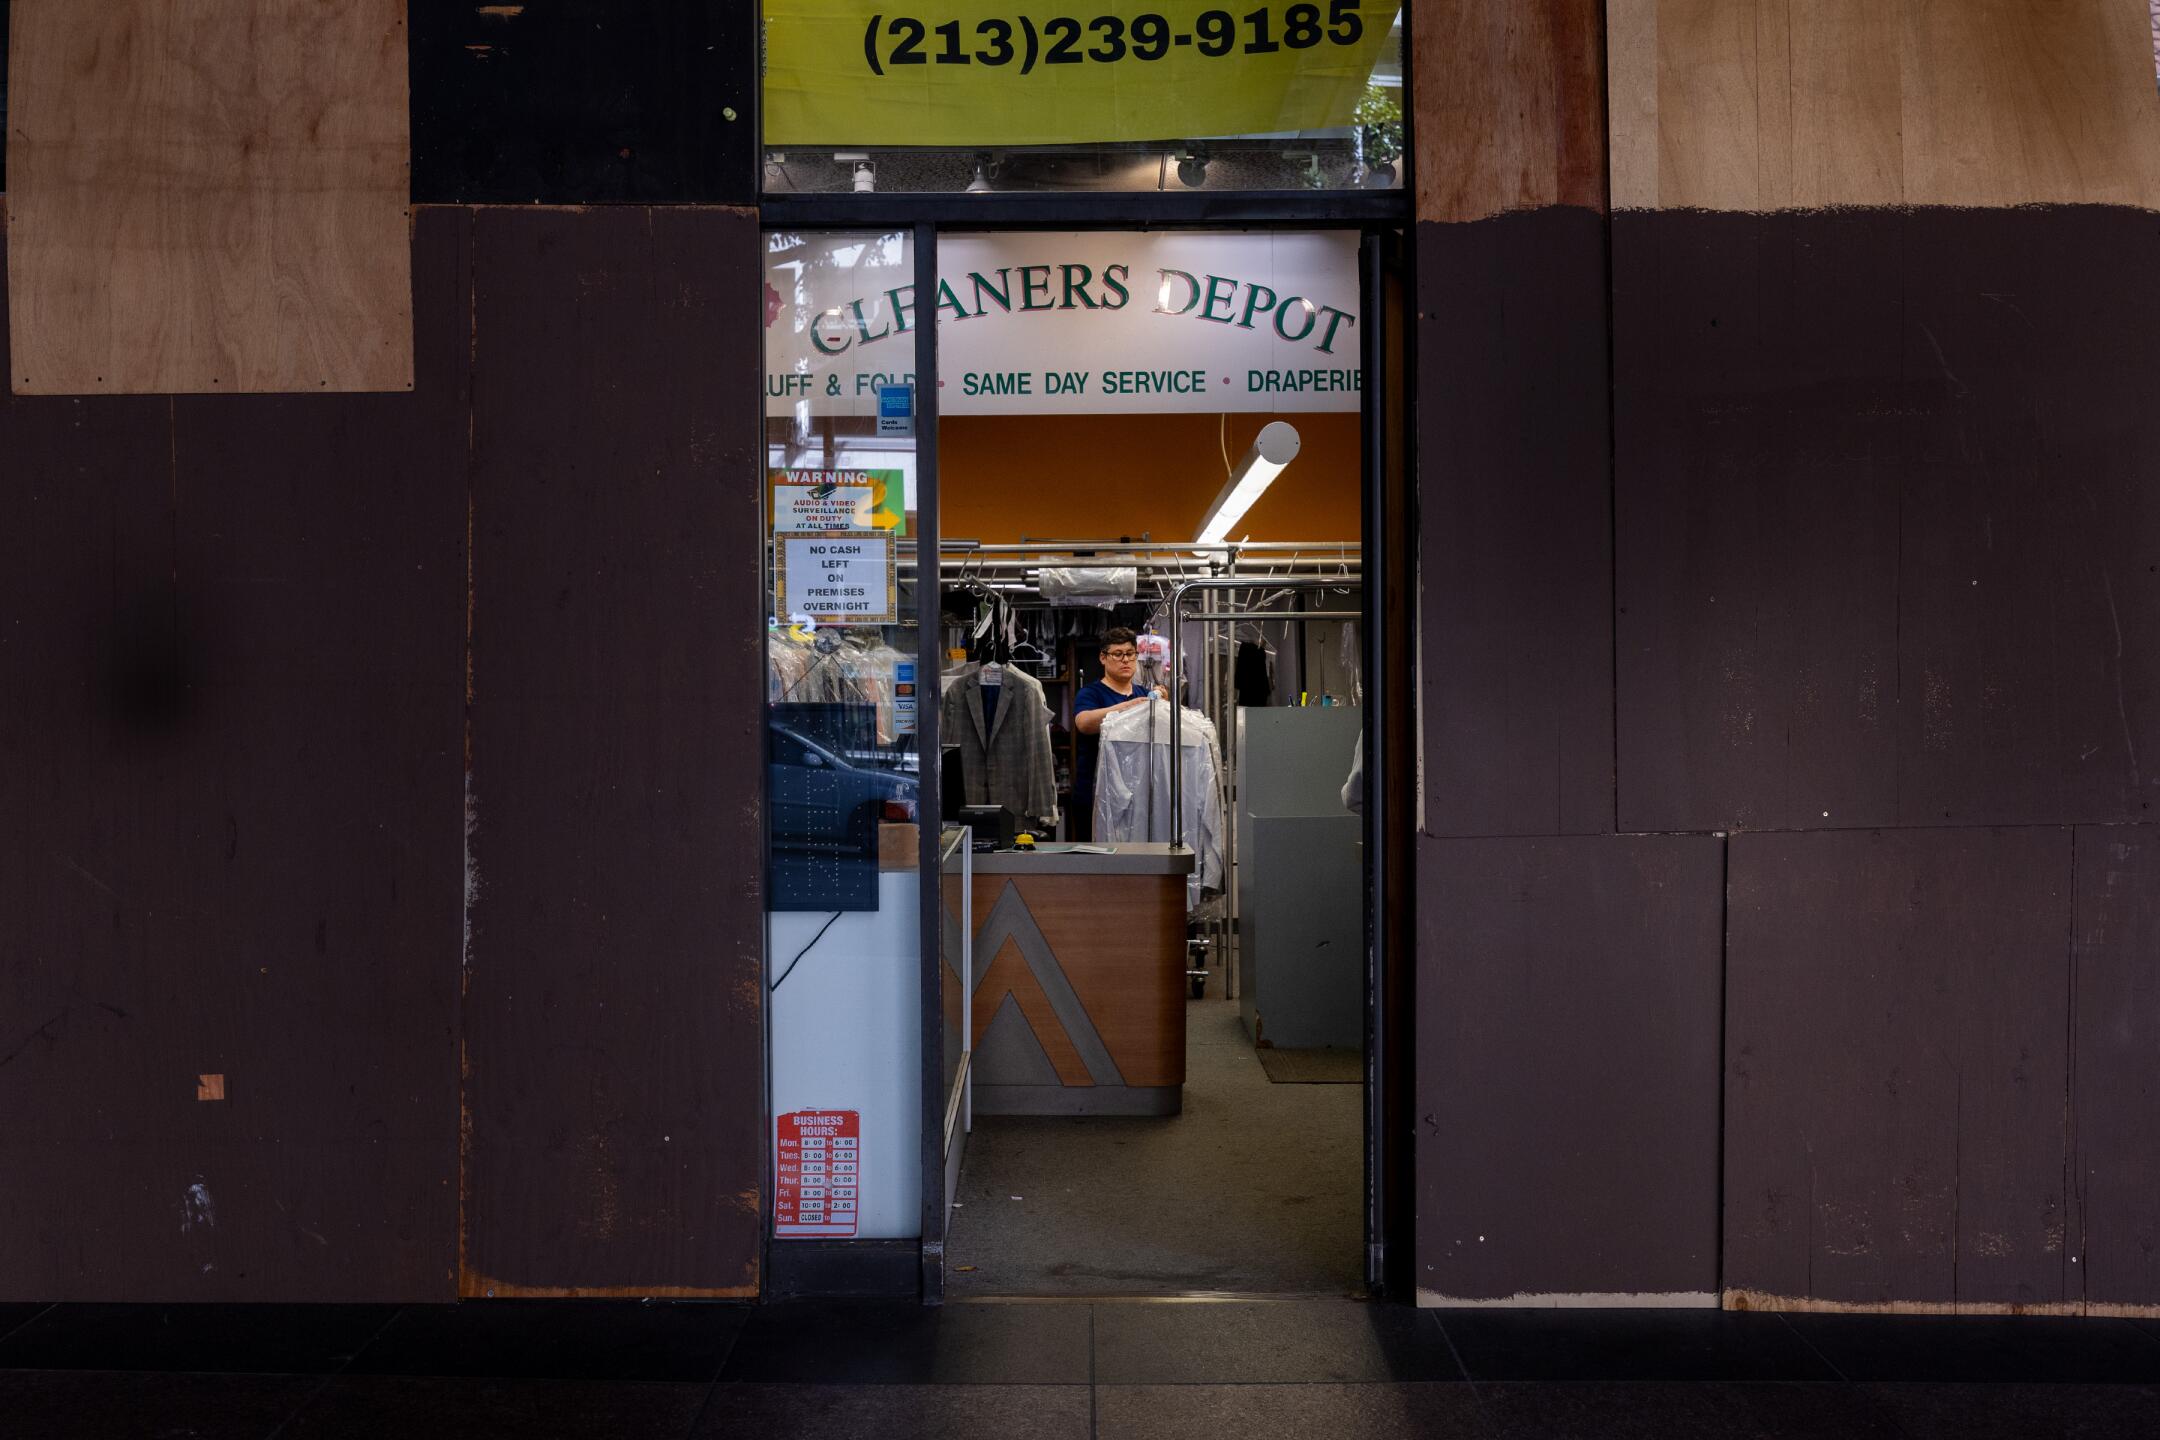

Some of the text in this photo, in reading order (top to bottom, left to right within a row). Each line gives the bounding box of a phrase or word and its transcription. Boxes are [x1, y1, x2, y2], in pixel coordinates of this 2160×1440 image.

[864, 0, 1364, 76] (213)239-9185
[810, 263, 1357, 356] CLEANERS DEPOT
[766, 374, 814, 397] UFF
[825, 373, 842, 397] &
[963, 370, 1206, 396] SAME DAY SERVICE
[785, 471, 868, 484] WARNING
[809, 546, 861, 554] NO CASH
[821, 560, 850, 568] LEFT
[827, 574, 844, 582] ON
[807, 588, 865, 596] PREMISES
[803, 602, 870, 611] OVERNIGHT
[793, 1115, 844, 1126] BUSINESS
[800, 1127, 838, 1136] HOURS:
[801, 1213, 822, 1221] CLOSED
